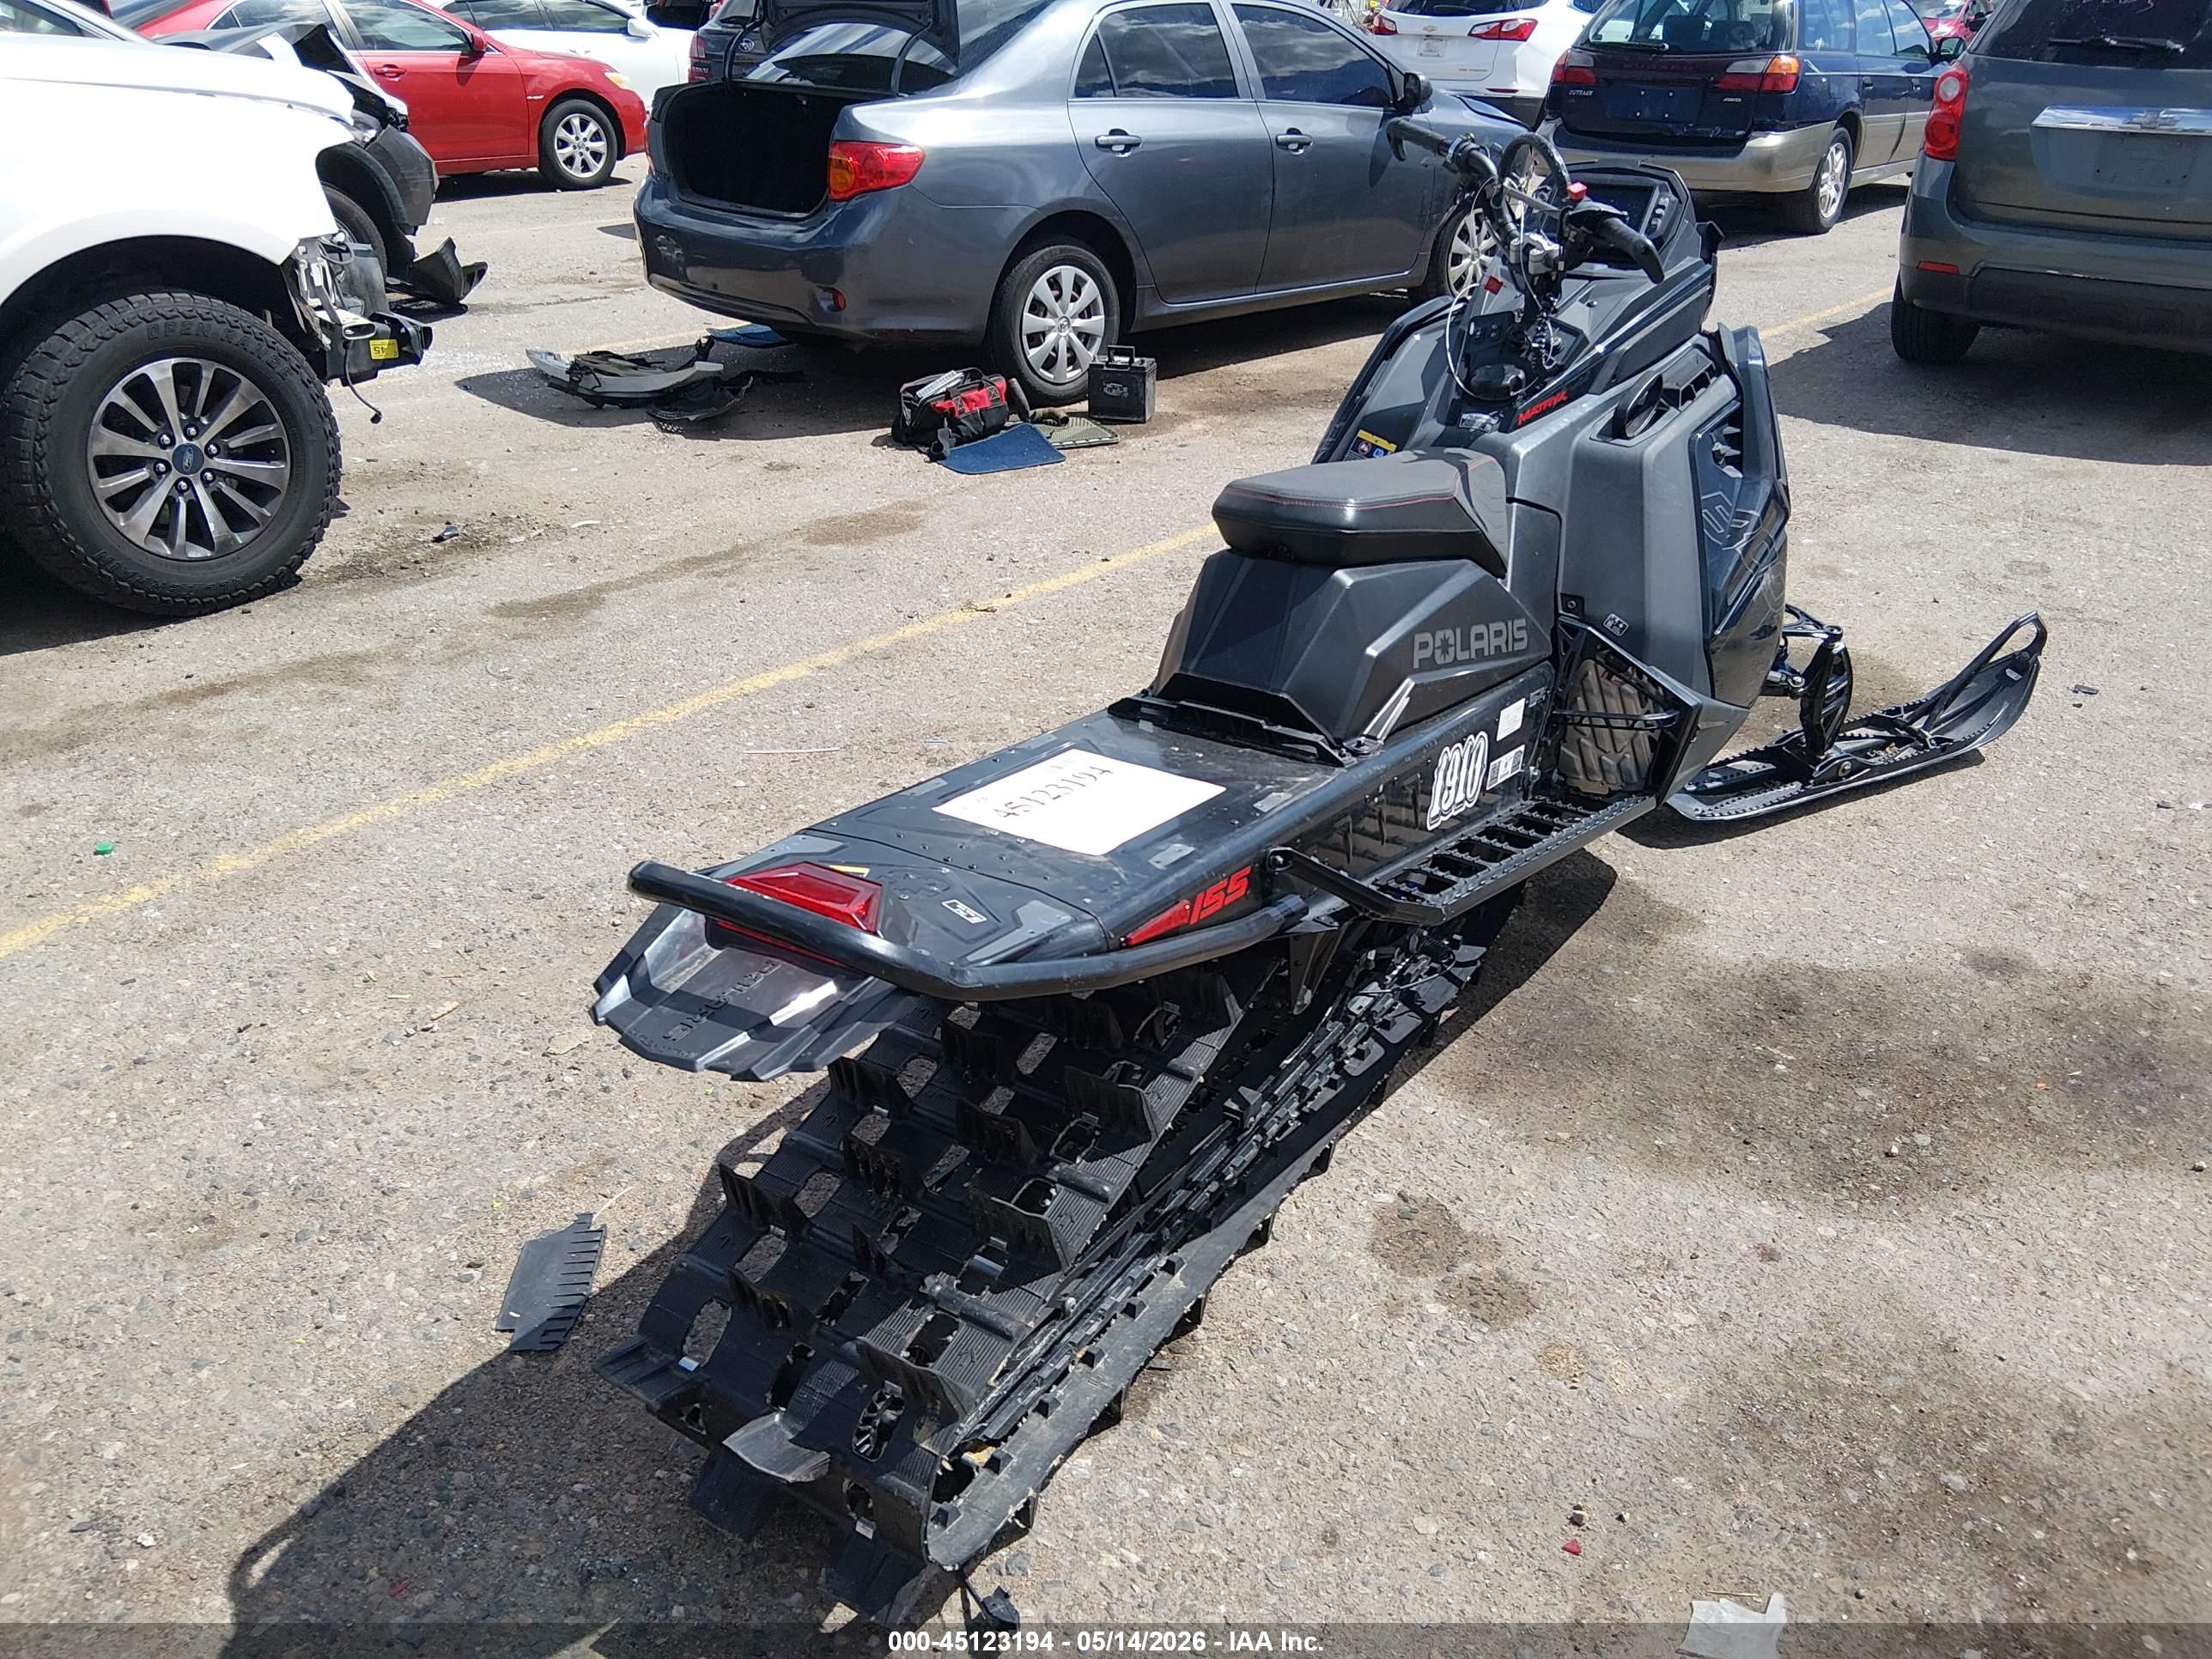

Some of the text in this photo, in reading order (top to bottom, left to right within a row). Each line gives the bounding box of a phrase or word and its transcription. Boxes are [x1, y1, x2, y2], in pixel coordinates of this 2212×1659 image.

[146, 320, 211, 340] OPEN
[1413, 617, 1528, 669] POLARIS
[994, 766, 1114, 817] 45123194
[1427, 732, 1489, 830] 1910
[1188, 866, 1253, 926] 155
